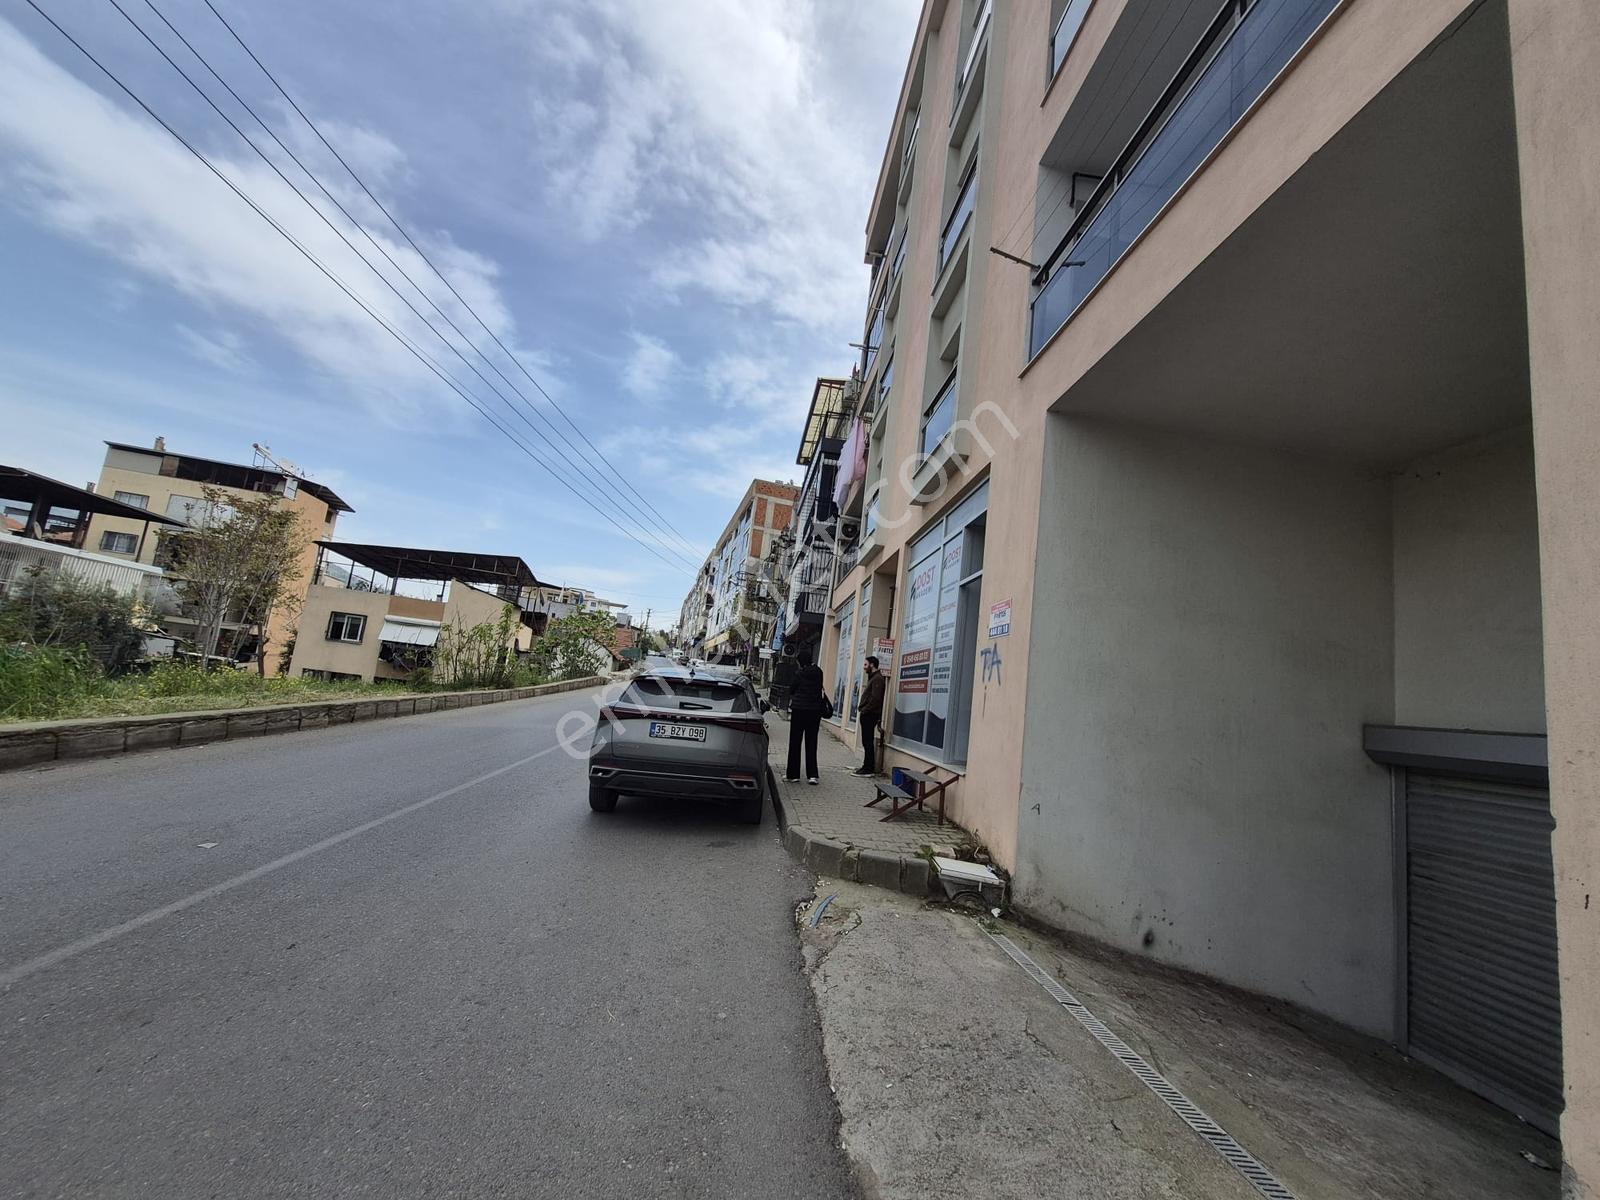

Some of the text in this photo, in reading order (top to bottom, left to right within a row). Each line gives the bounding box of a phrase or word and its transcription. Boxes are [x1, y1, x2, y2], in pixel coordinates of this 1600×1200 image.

[916, 565, 936, 590] DOST
[656, 725, 704, 738] 35 BZY 098
